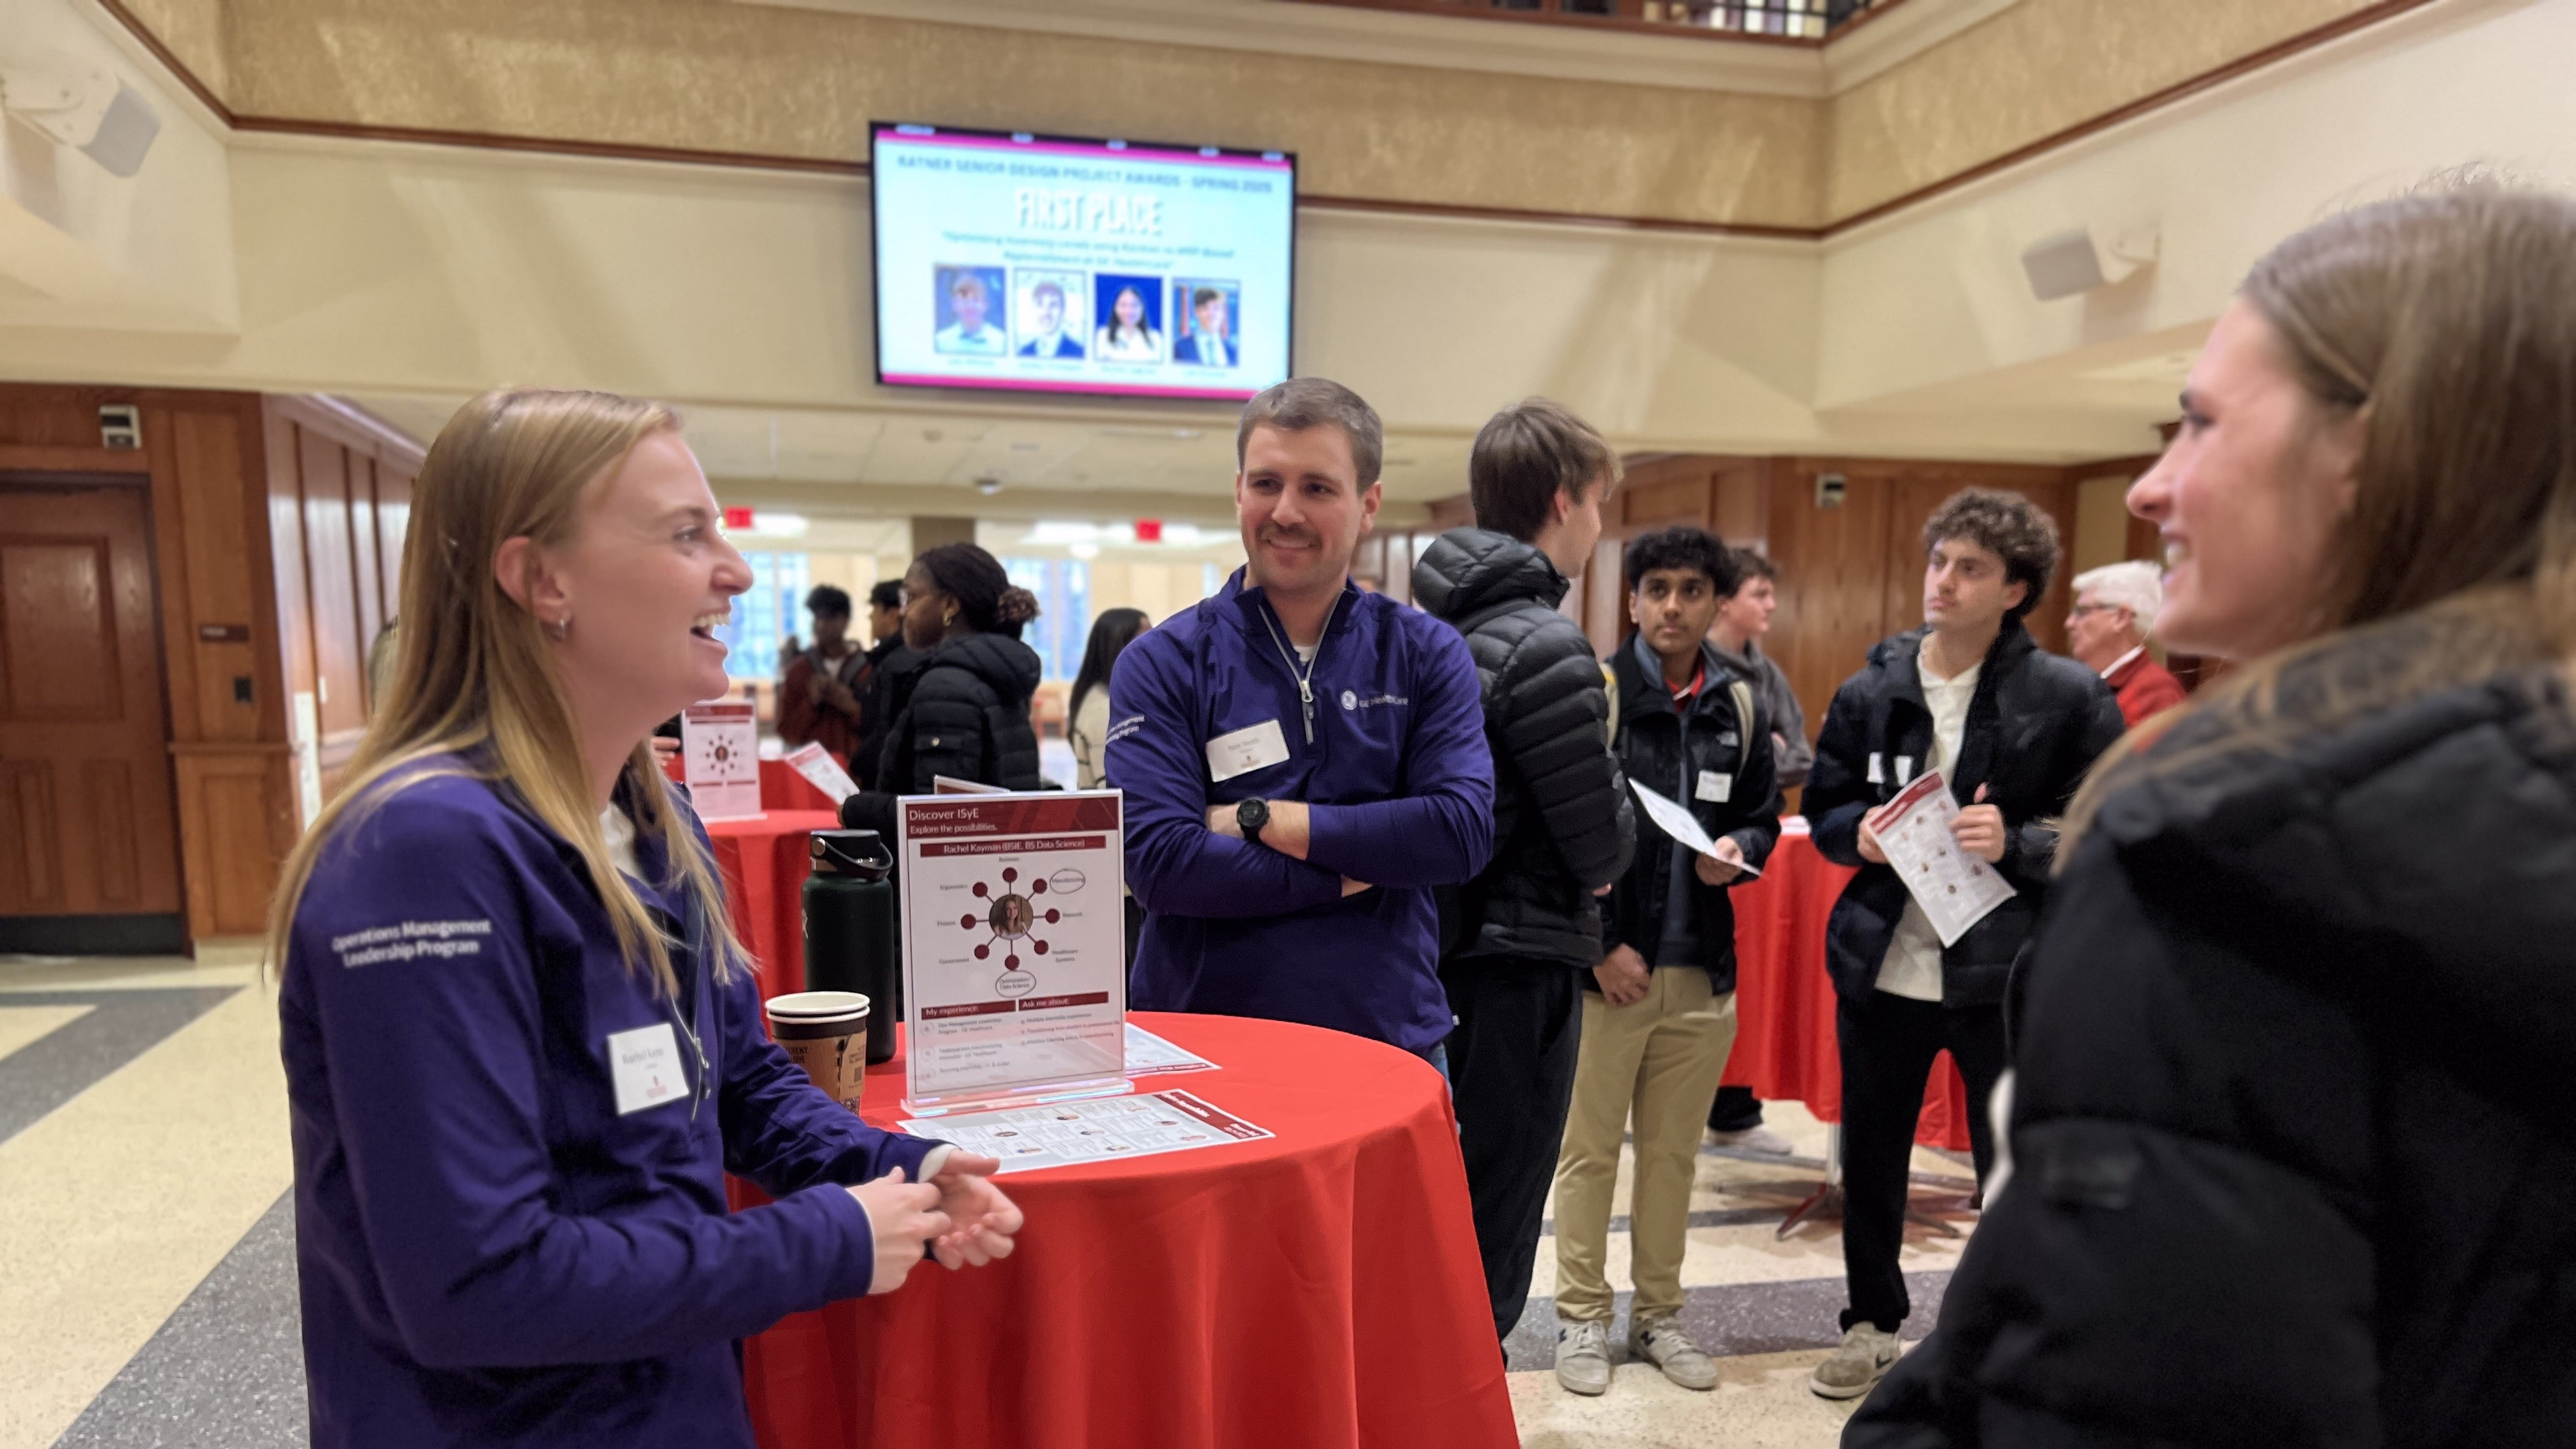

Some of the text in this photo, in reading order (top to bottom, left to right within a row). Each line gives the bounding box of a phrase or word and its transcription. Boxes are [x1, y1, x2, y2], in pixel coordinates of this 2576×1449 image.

[898, 156, 951, 170] RATNER
[956, 160, 1005, 173] SENIOR
[1009, 162, 1059, 178] DESIGN
[1062, 167, 1122, 182] PROJECT
[1126, 172, 1181, 187] AWARDS
[1192, 176, 1239, 191] SPRING
[1015, 186, 1163, 237] FIRST PLACE
[909, 807, 979, 821] Discover ISyE
[910, 822, 998, 834] Explore the possibilities.
[944, 843, 970, 854] Rachel
[970, 842, 1002, 853] Kayman
[1025, 840, 1035, 850] BS
[1036, 839, 1054, 849] Data
[1055, 838, 1085, 848] Science)
[332, 919, 491, 952] Operations Management
[342, 939, 480, 968] Leadership Program
[1022, 1000, 1036, 1008] Ask
[1048, 997, 1070, 1006] about:
[926, 1005, 979, 1017] My experience:
